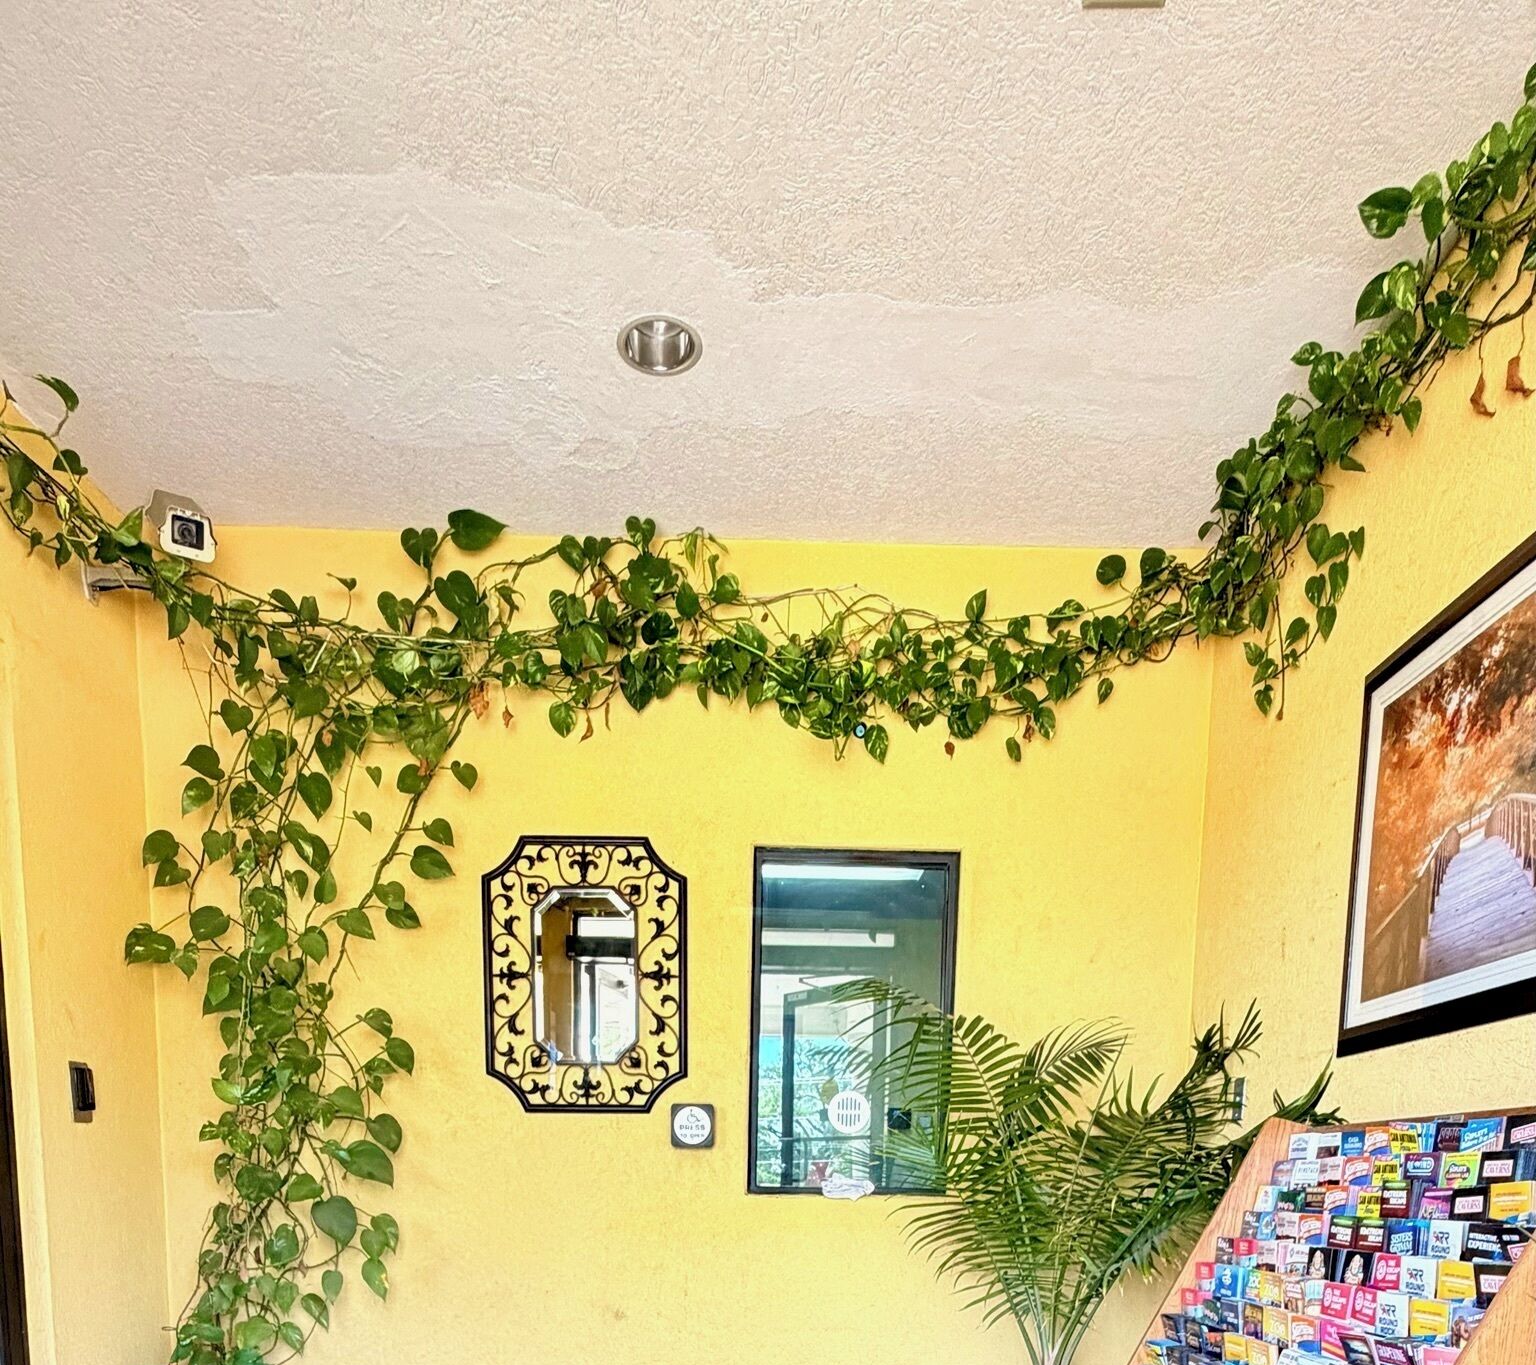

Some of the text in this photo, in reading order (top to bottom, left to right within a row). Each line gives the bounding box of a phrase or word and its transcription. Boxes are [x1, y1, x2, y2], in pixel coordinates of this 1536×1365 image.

[1431, 1245, 1450, 1254] ROUND
[1406, 1281, 1425, 1292] ROUND
[1379, 1317, 1398, 1327] ROUND
[1381, 1326, 1396, 1335] ROCK
